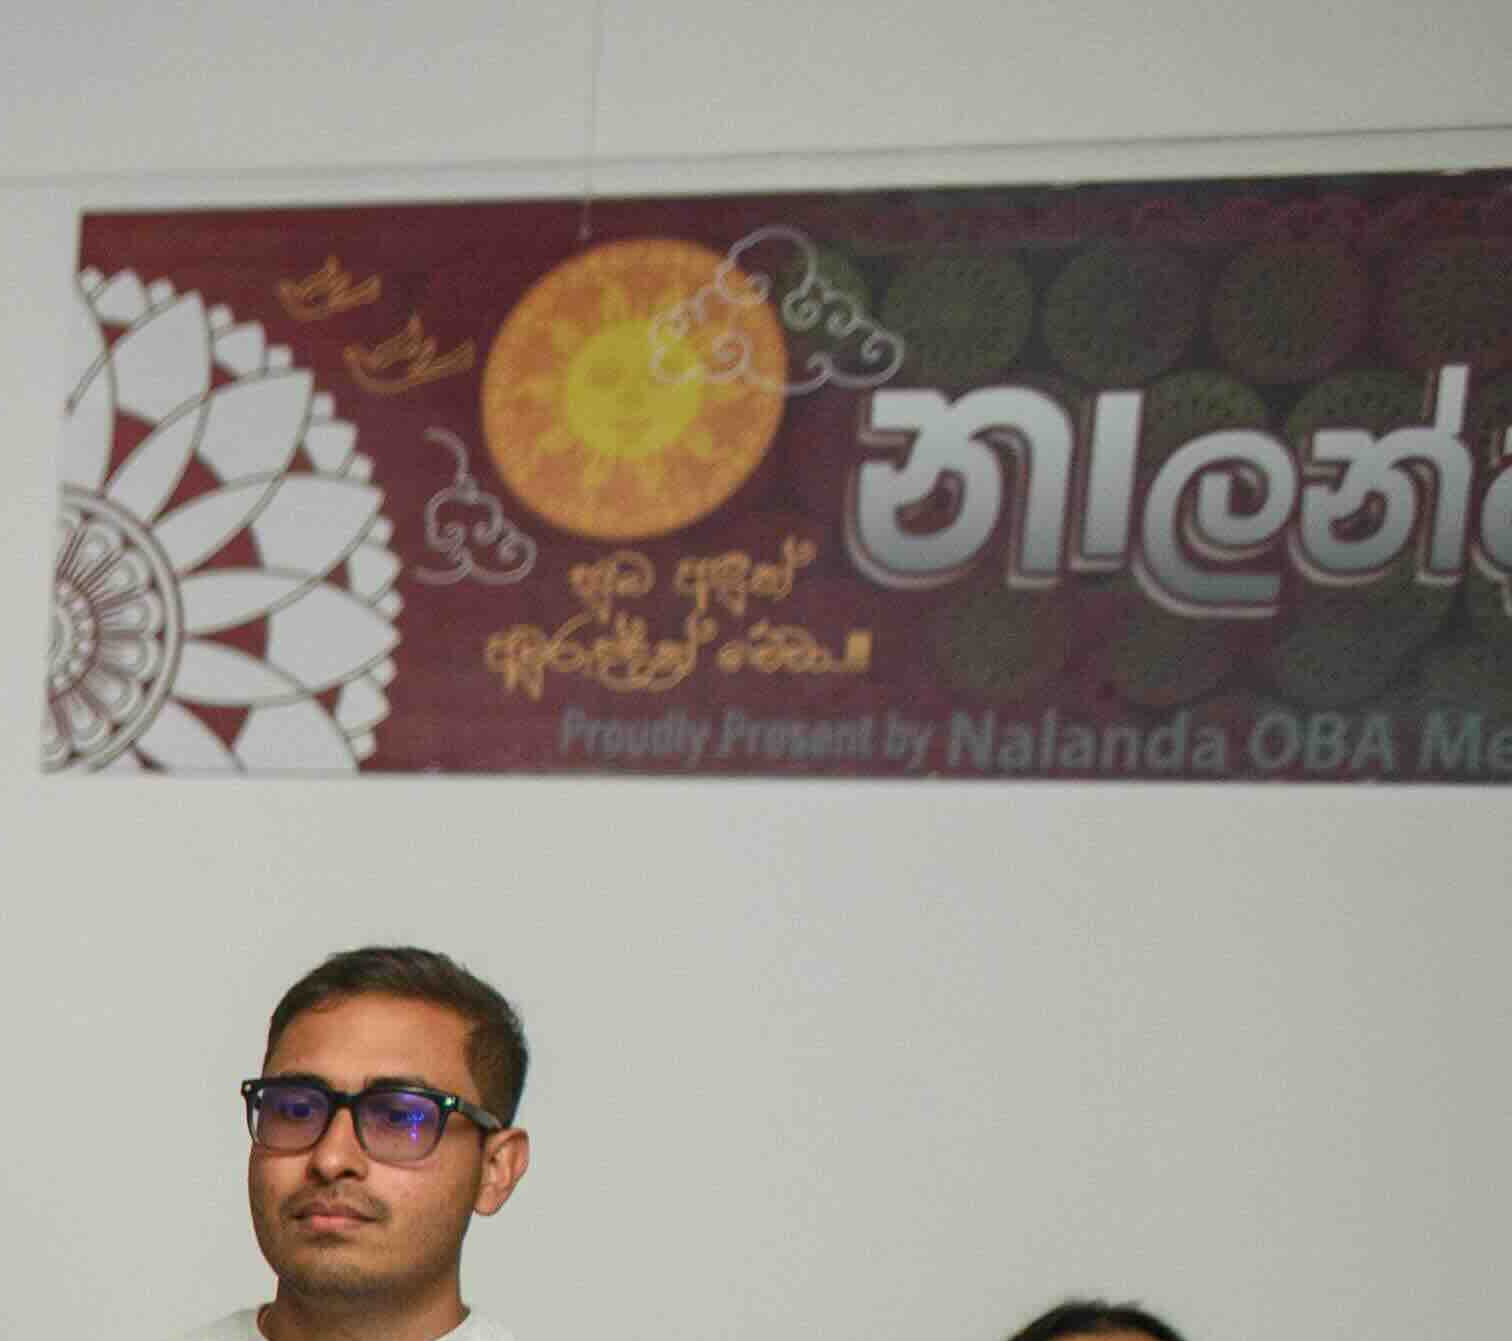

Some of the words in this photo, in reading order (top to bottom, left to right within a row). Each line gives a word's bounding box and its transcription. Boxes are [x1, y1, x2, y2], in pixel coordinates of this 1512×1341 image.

[562, 704, 710, 769] Proudly
[719, 706, 873, 759] Present
[884, 707, 933, 769] by
[949, 708, 1225, 771] Nalanda
[1249, 710, 1397, 771] OBA
